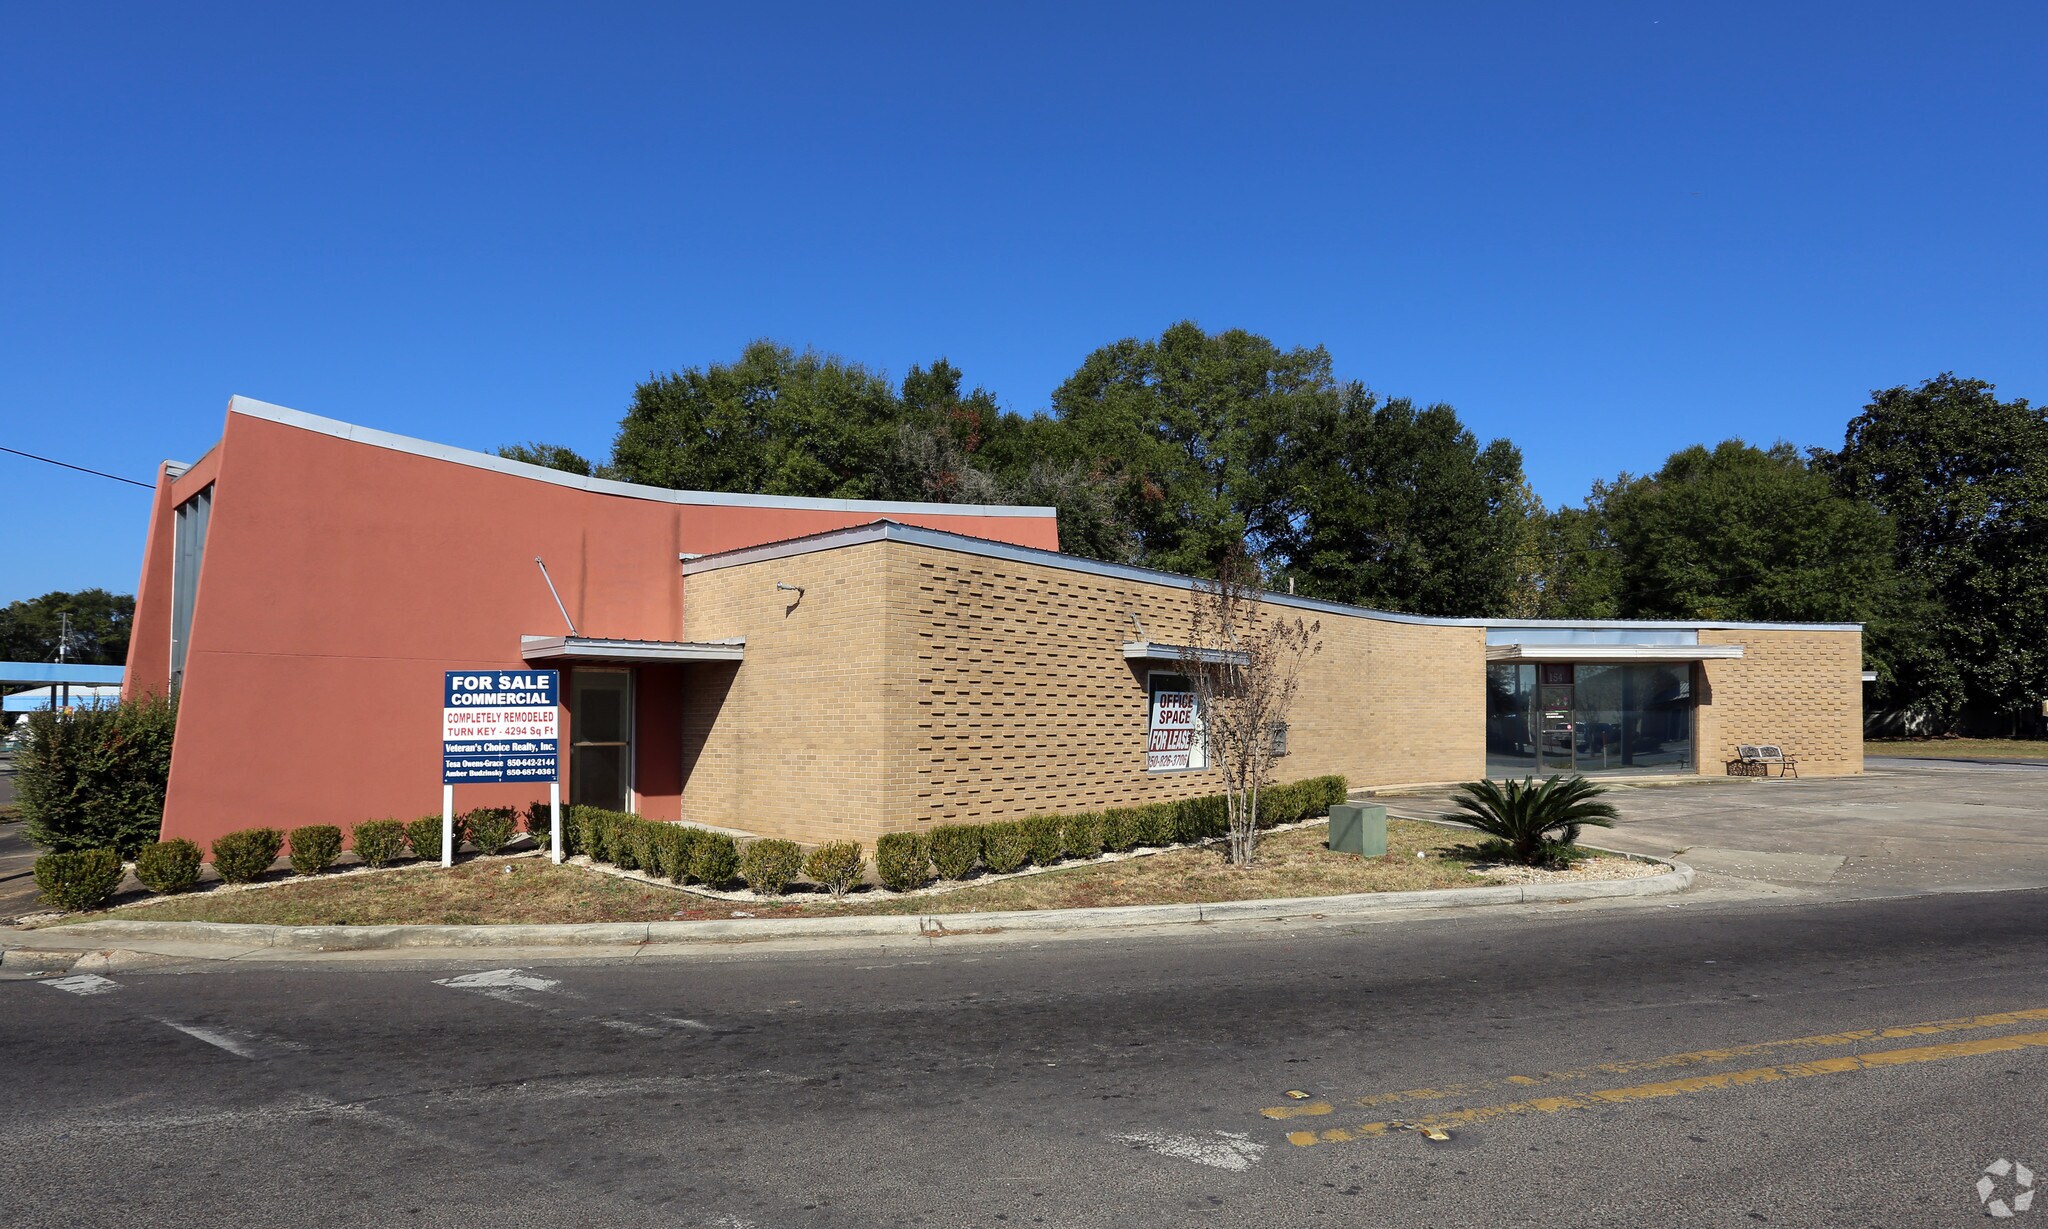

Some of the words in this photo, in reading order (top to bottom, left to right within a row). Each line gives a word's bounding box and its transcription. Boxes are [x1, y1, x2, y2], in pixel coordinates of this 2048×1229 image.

[452, 676, 493, 690] FOR
[498, 675, 549, 690] SALE
[451, 693, 550, 705] COMMERCIAL
[1160, 694, 1194, 708] OFFICE
[447, 712, 501, 723] COMPLETELY
[504, 711, 554, 722] REMODELED
[1159, 710, 1191, 724] SPACE
[448, 727, 473, 736] TURN
[477, 727, 496, 736] KEY
[505, 726, 527, 735] 4294
[530, 726, 541, 737] Sq
[544, 726, 554, 735] Ft
[1151, 730, 1167, 750] FOR
[1168, 730, 1190, 750] LEASE
[445, 743, 482, 753] Veteran's
[483, 742, 510, 752] Choice
[512, 742, 539, 753] Realty,
[540, 742, 555, 751] Inc.
[445, 760, 461, 768] Tesa
[462, 759, 504, 768] Owens-Grace
[506, 758, 555, 767] 850-642-2144
[1148, 754, 1187, 767] 50-826-3706
[469, 769, 503, 778] Budzinsky
[506, 768, 555, 776] 850-687-0361
